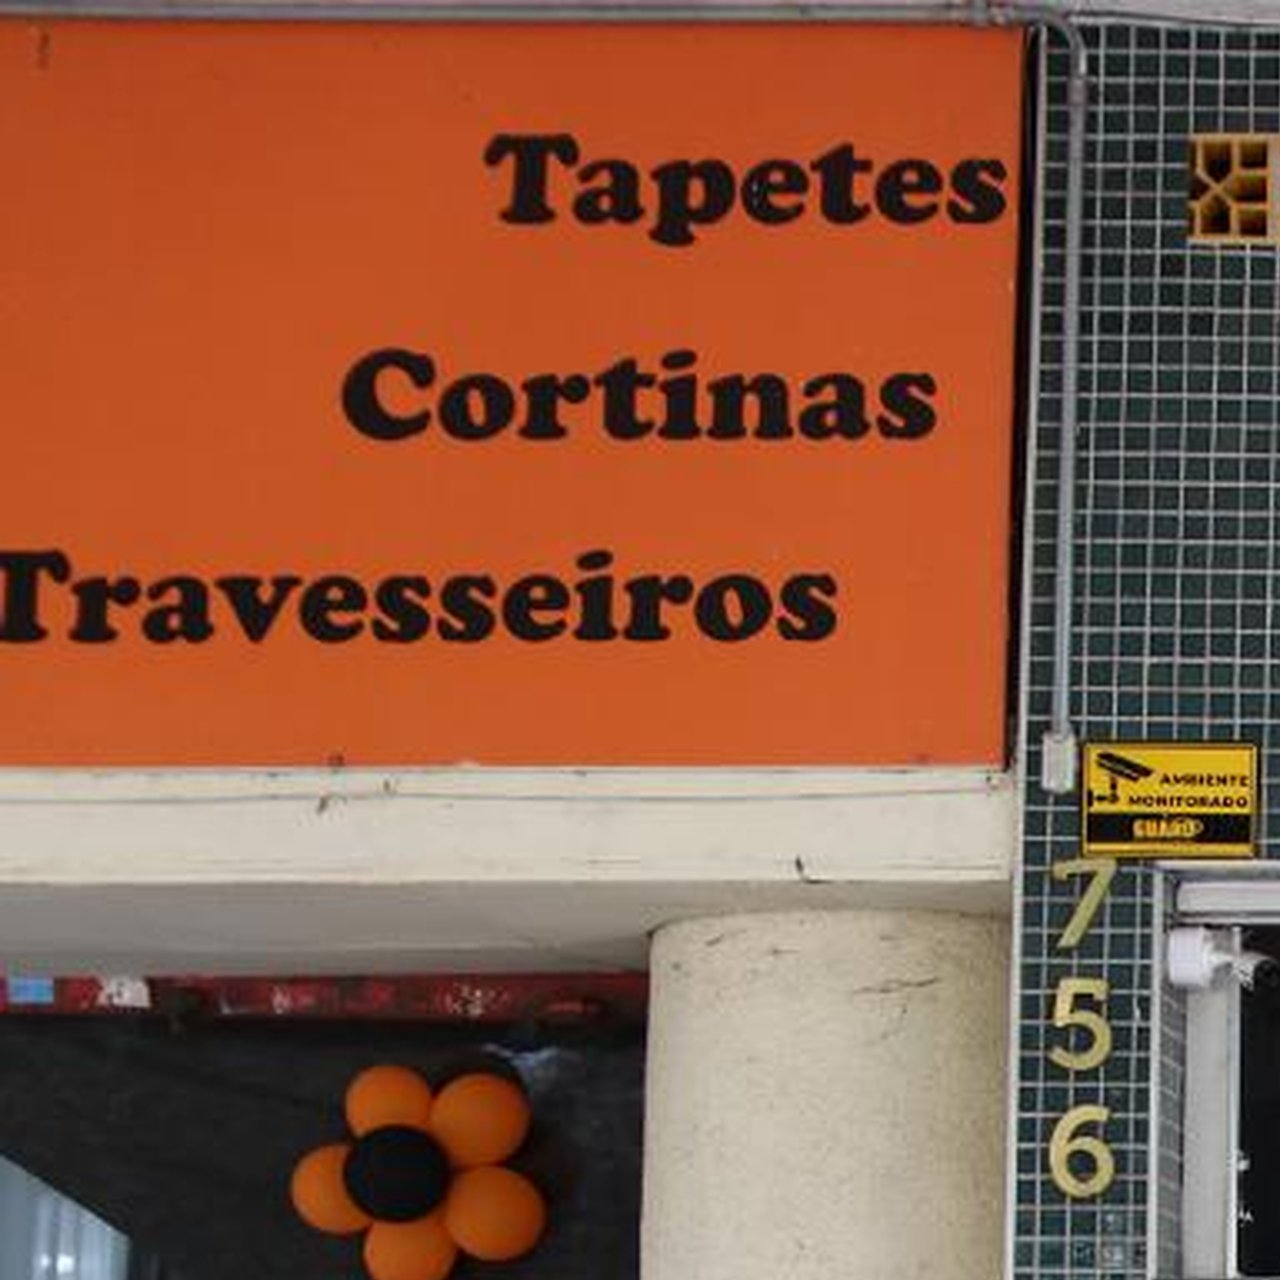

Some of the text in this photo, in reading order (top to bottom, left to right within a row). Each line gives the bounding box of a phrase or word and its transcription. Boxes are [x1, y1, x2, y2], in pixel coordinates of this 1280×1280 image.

[484, 133, 1007, 246] Tapetes
[340, 348, 937, 443] Cortinas
[0, 549, 838, 644] Travesseiros
[1128, 794, 1249, 808] MONITORADO
[1159, 772, 1250, 788] AMBIENTE
